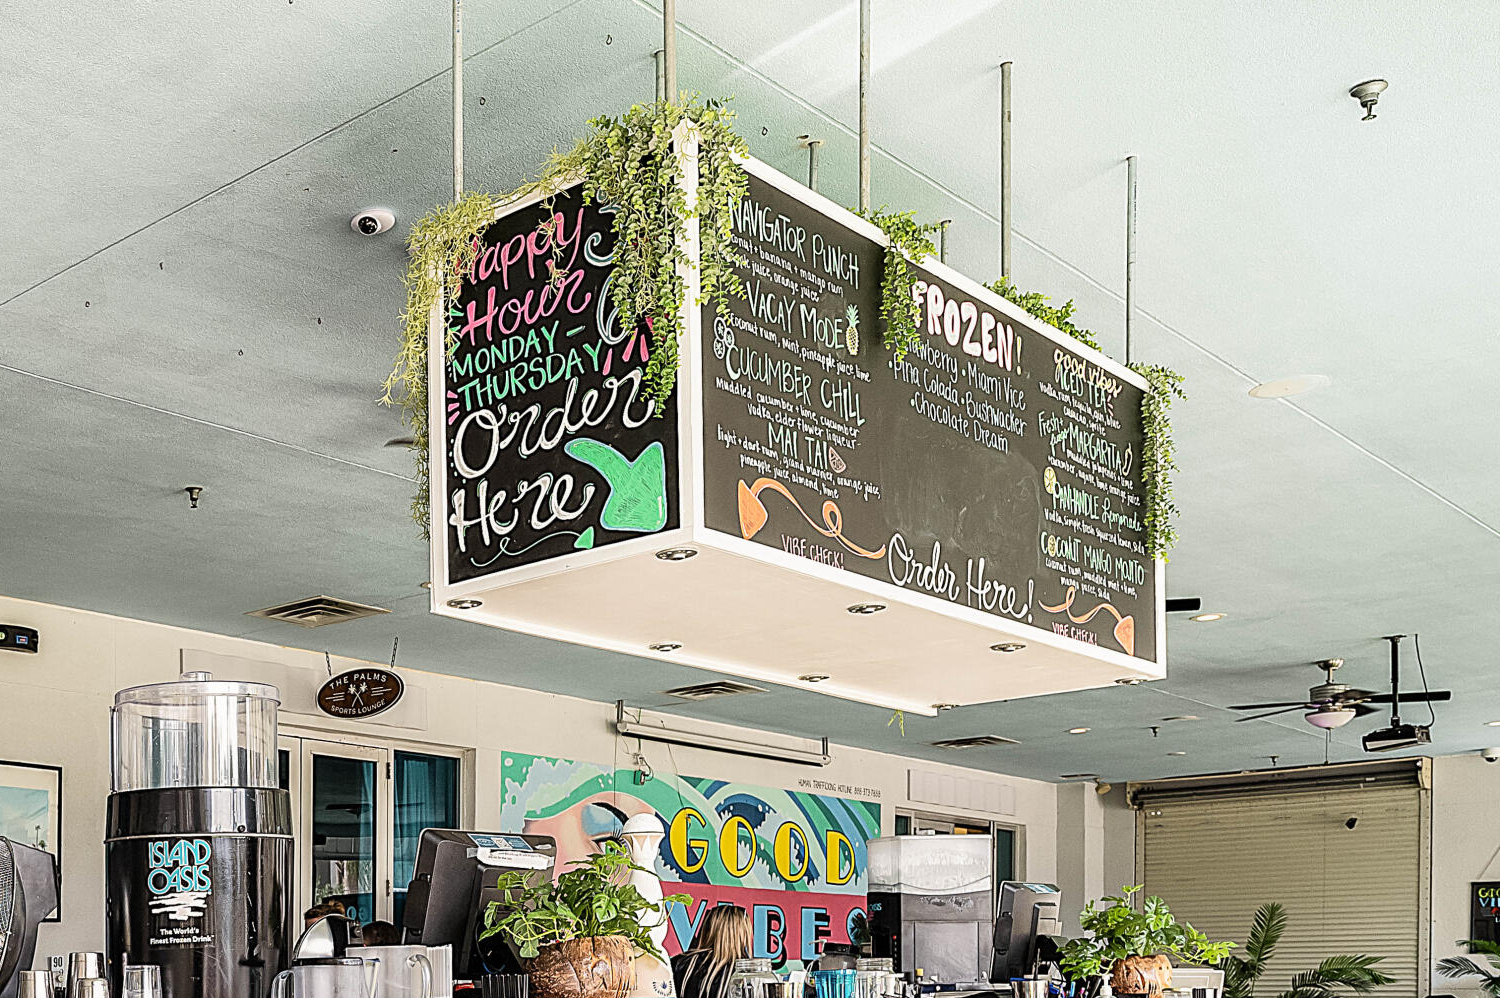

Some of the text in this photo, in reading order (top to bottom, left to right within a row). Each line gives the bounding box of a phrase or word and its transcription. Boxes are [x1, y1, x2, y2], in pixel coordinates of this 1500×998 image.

[728, 196, 860, 290] NAVIGATOR PUNCH
[759, 245, 793, 274] banana
[799, 268, 826, 293] mango
[827, 281, 844, 298] rum
[460, 269, 592, 346] Hour
[746, 280, 845, 350] VACAY MODE
[453, 320, 560, 383] MONDAY
[457, 340, 602, 411] THURSDAY
[1054, 348, 1122, 398] good vibes
[726, 345, 865, 427] CUCUMBER CHILL
[923, 368, 960, 407] Colada
[965, 391, 1027, 437] Bushwacker
[967, 361, 1002, 401] Miami
[1003, 377, 1026, 411] Vice
[1060, 364, 1107, 413] ICED TEA
[453, 366, 655, 479] Order
[717, 424, 737, 449] light
[768, 422, 828, 470] MAI TAI
[819, 415, 860, 438] cucumber
[914, 391, 1009, 455] Chocolate Dream
[1069, 421, 1122, 476] MARGARITA
[449, 473, 595, 552] Here
[1052, 481, 1100, 520] PANHANDLE
[781, 534, 844, 570] VIBE CHECK!
[1083, 544, 1112, 575] MANGO
[1115, 557, 1145, 586] MOJITO
[887, 532, 1034, 624] Order Here!
[329, 672, 387, 690] THE PALMS
[330, 698, 386, 715] SPORTS LOUNGE
[148, 839, 212, 868] ISLAND
[669, 807, 856, 886] GOOD
[147, 865, 212, 895] OASIS
[169, 936, 192, 944] Frozen
[173, 927, 200, 935] World's
[53, 956, 63, 968] 90
